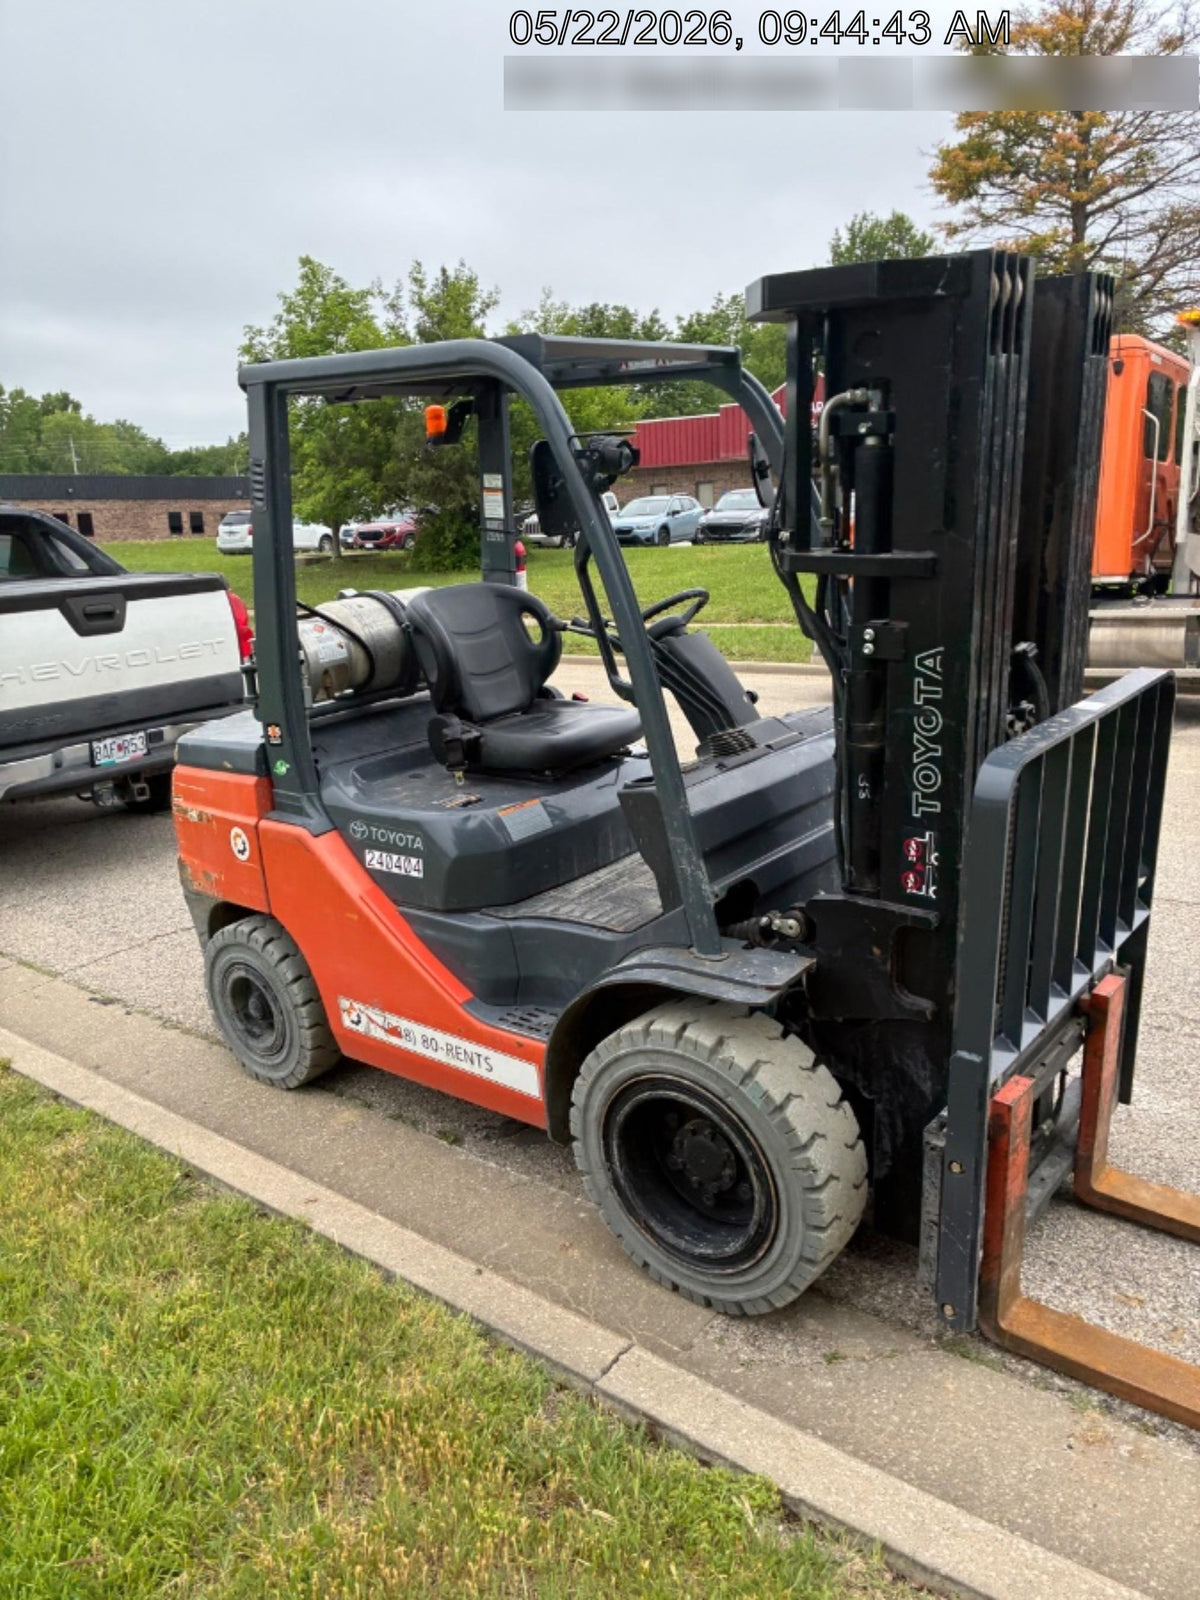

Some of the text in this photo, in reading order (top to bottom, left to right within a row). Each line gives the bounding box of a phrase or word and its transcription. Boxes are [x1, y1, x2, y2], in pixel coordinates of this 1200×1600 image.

[0, 638, 225, 688] HEVROLET
[911, 646, 945, 818] TOYOTA
[370, 826, 424, 851] TOYOTA
[367, 850, 423, 876] 240404
[421, 1033, 494, 1073] 80-RENTS
